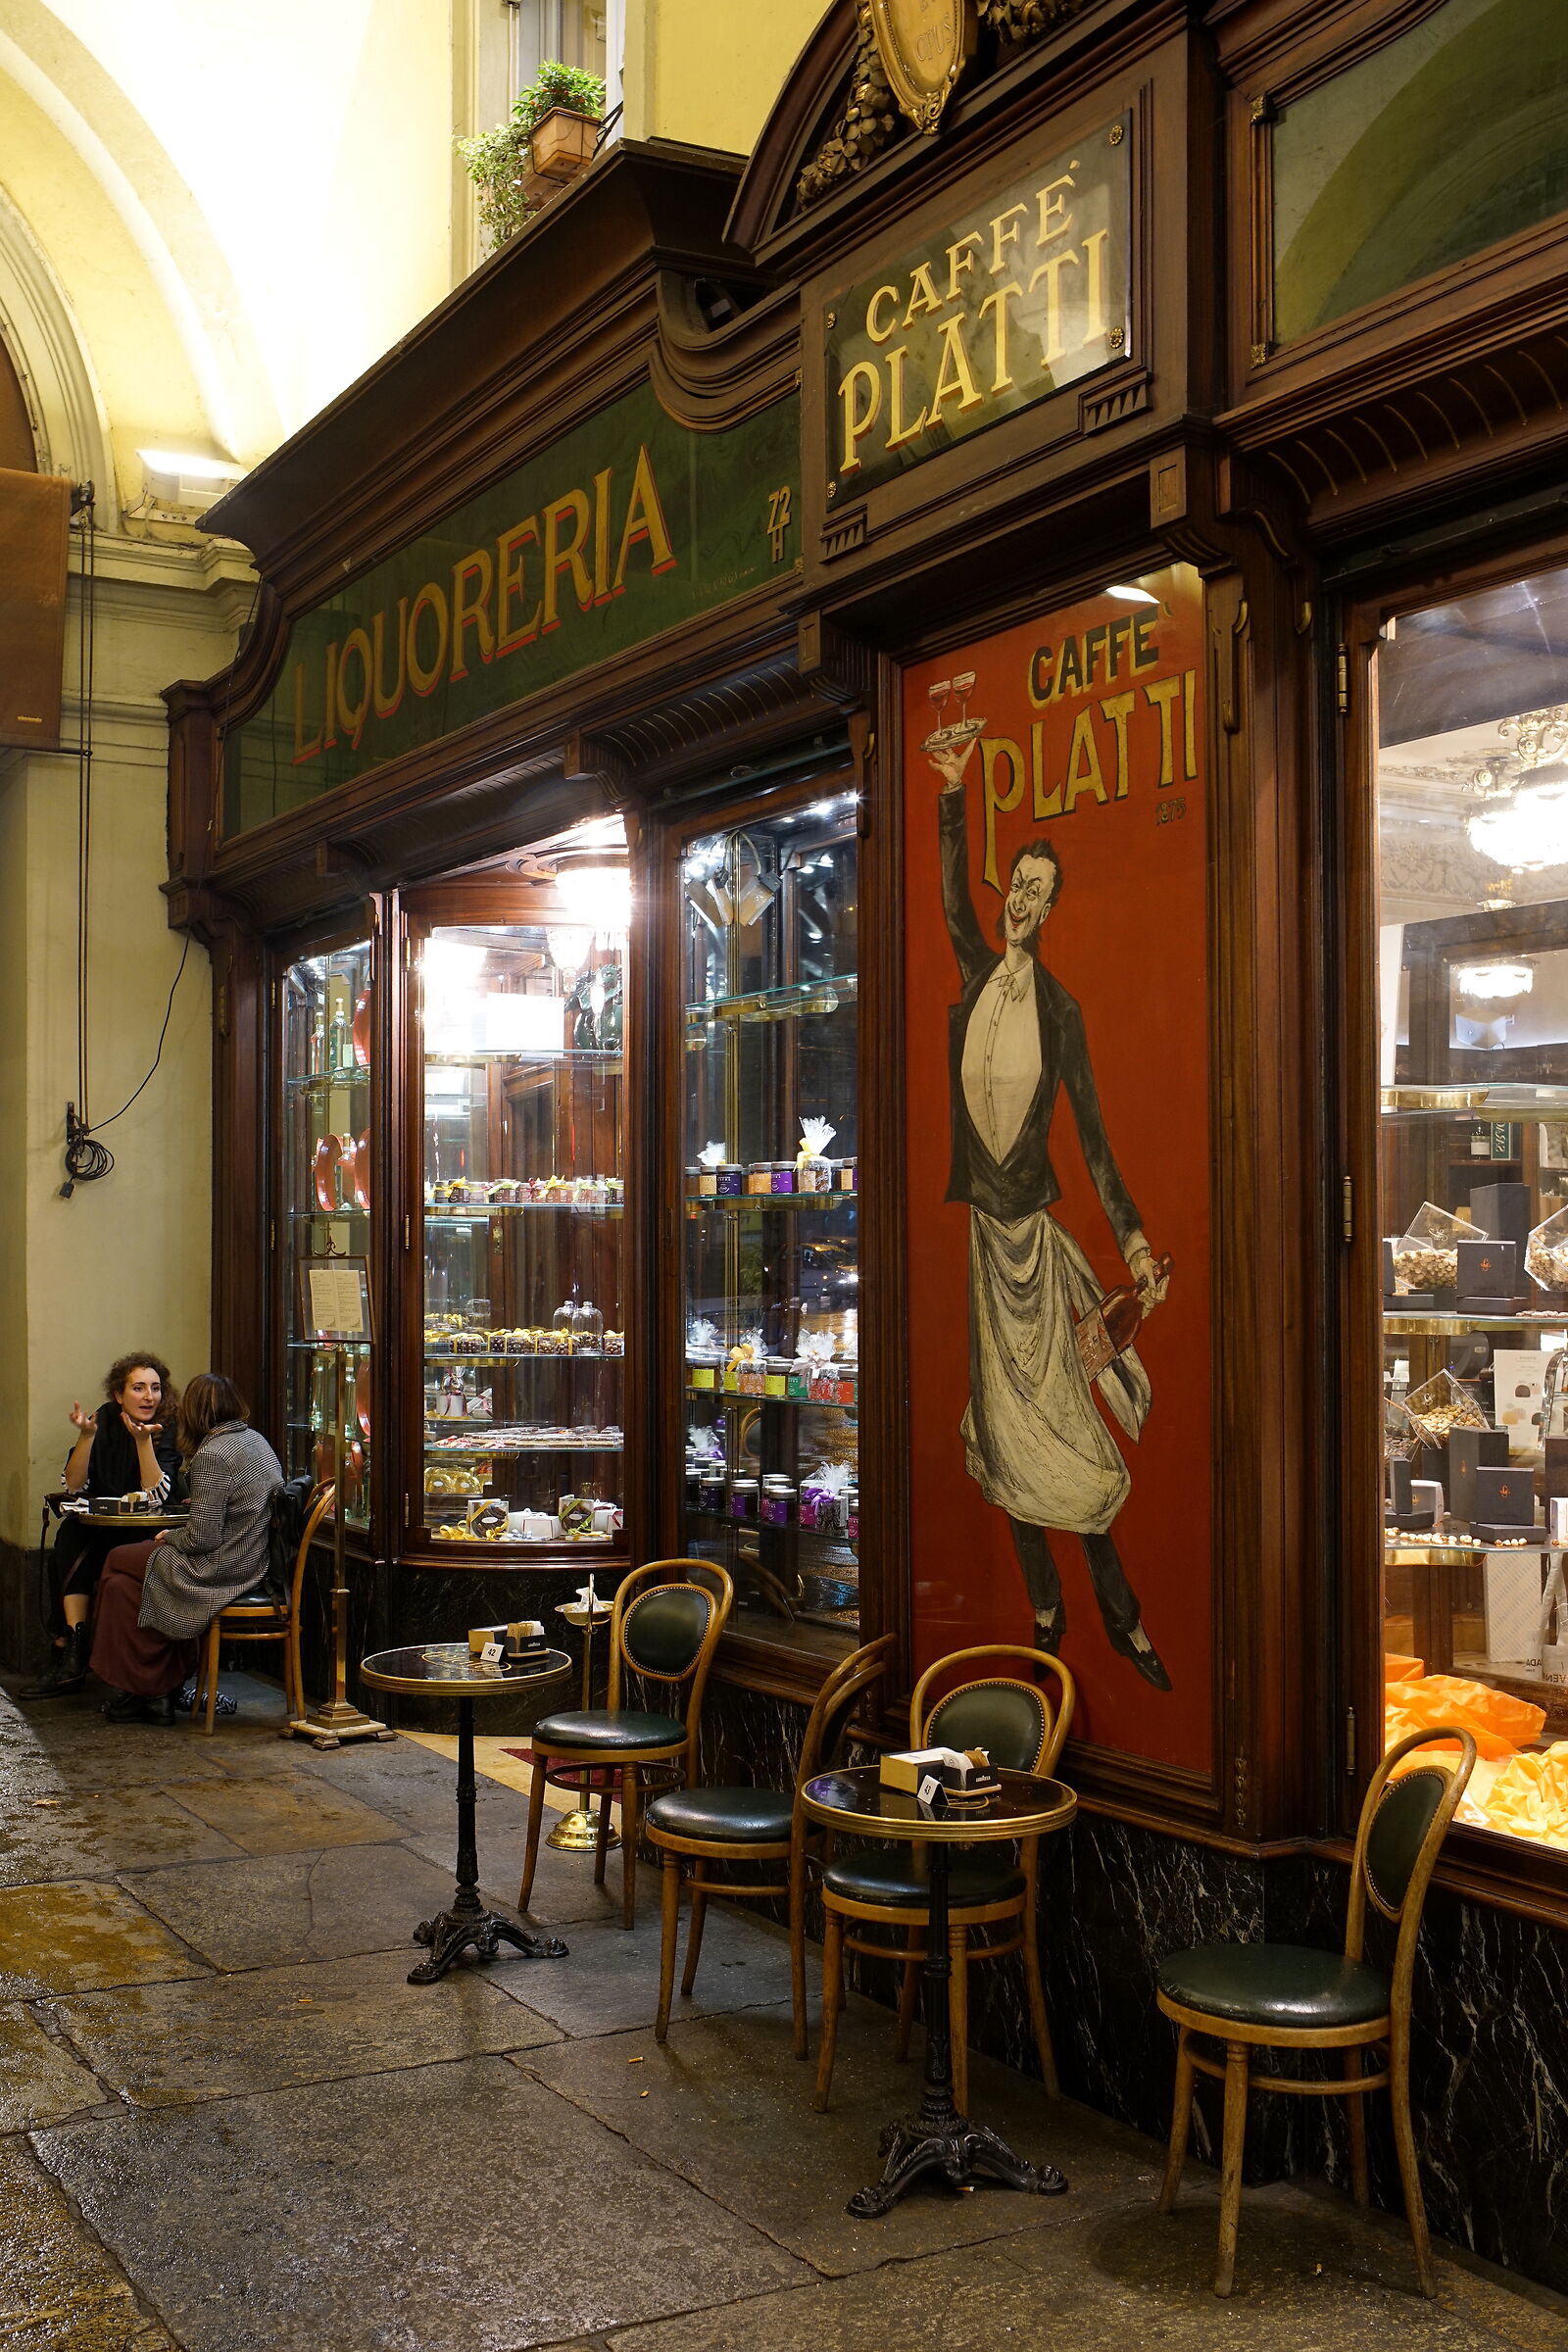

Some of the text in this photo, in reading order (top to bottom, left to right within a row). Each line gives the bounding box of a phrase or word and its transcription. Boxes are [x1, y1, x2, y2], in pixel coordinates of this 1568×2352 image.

[838, 228, 1108, 476] PLATTI
[294, 443, 677, 764] LIQUORERIA
[767, 486, 791, 535] 72
[980, 669, 1198, 899] PLATTI
[487, 1648, 496, 1657] 42
